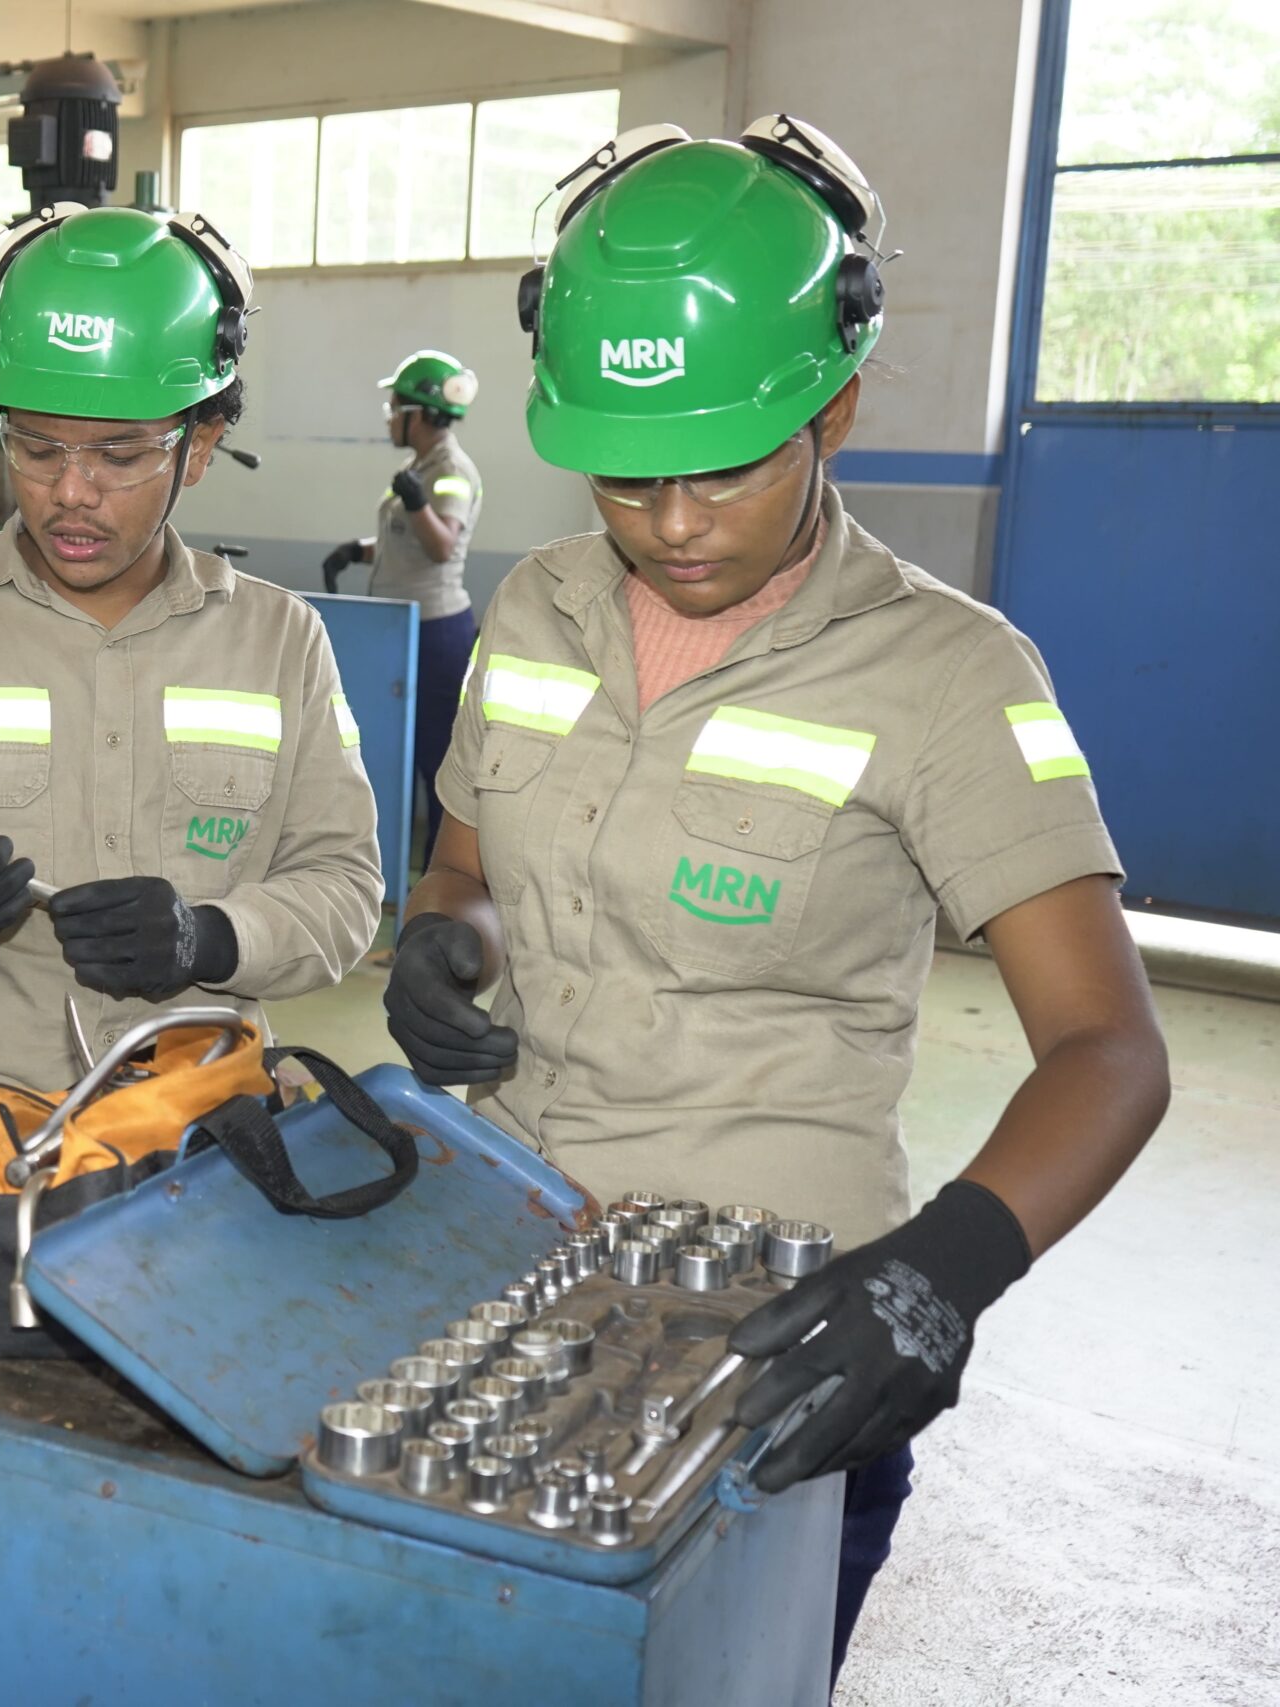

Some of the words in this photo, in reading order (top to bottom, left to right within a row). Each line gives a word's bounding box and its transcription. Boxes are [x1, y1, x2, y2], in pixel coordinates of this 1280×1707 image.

[48, 312, 115, 341] MRN
[601, 337, 685, 369] MRN
[186, 816, 250, 845] MRN
[671, 856, 782, 914] MRN
